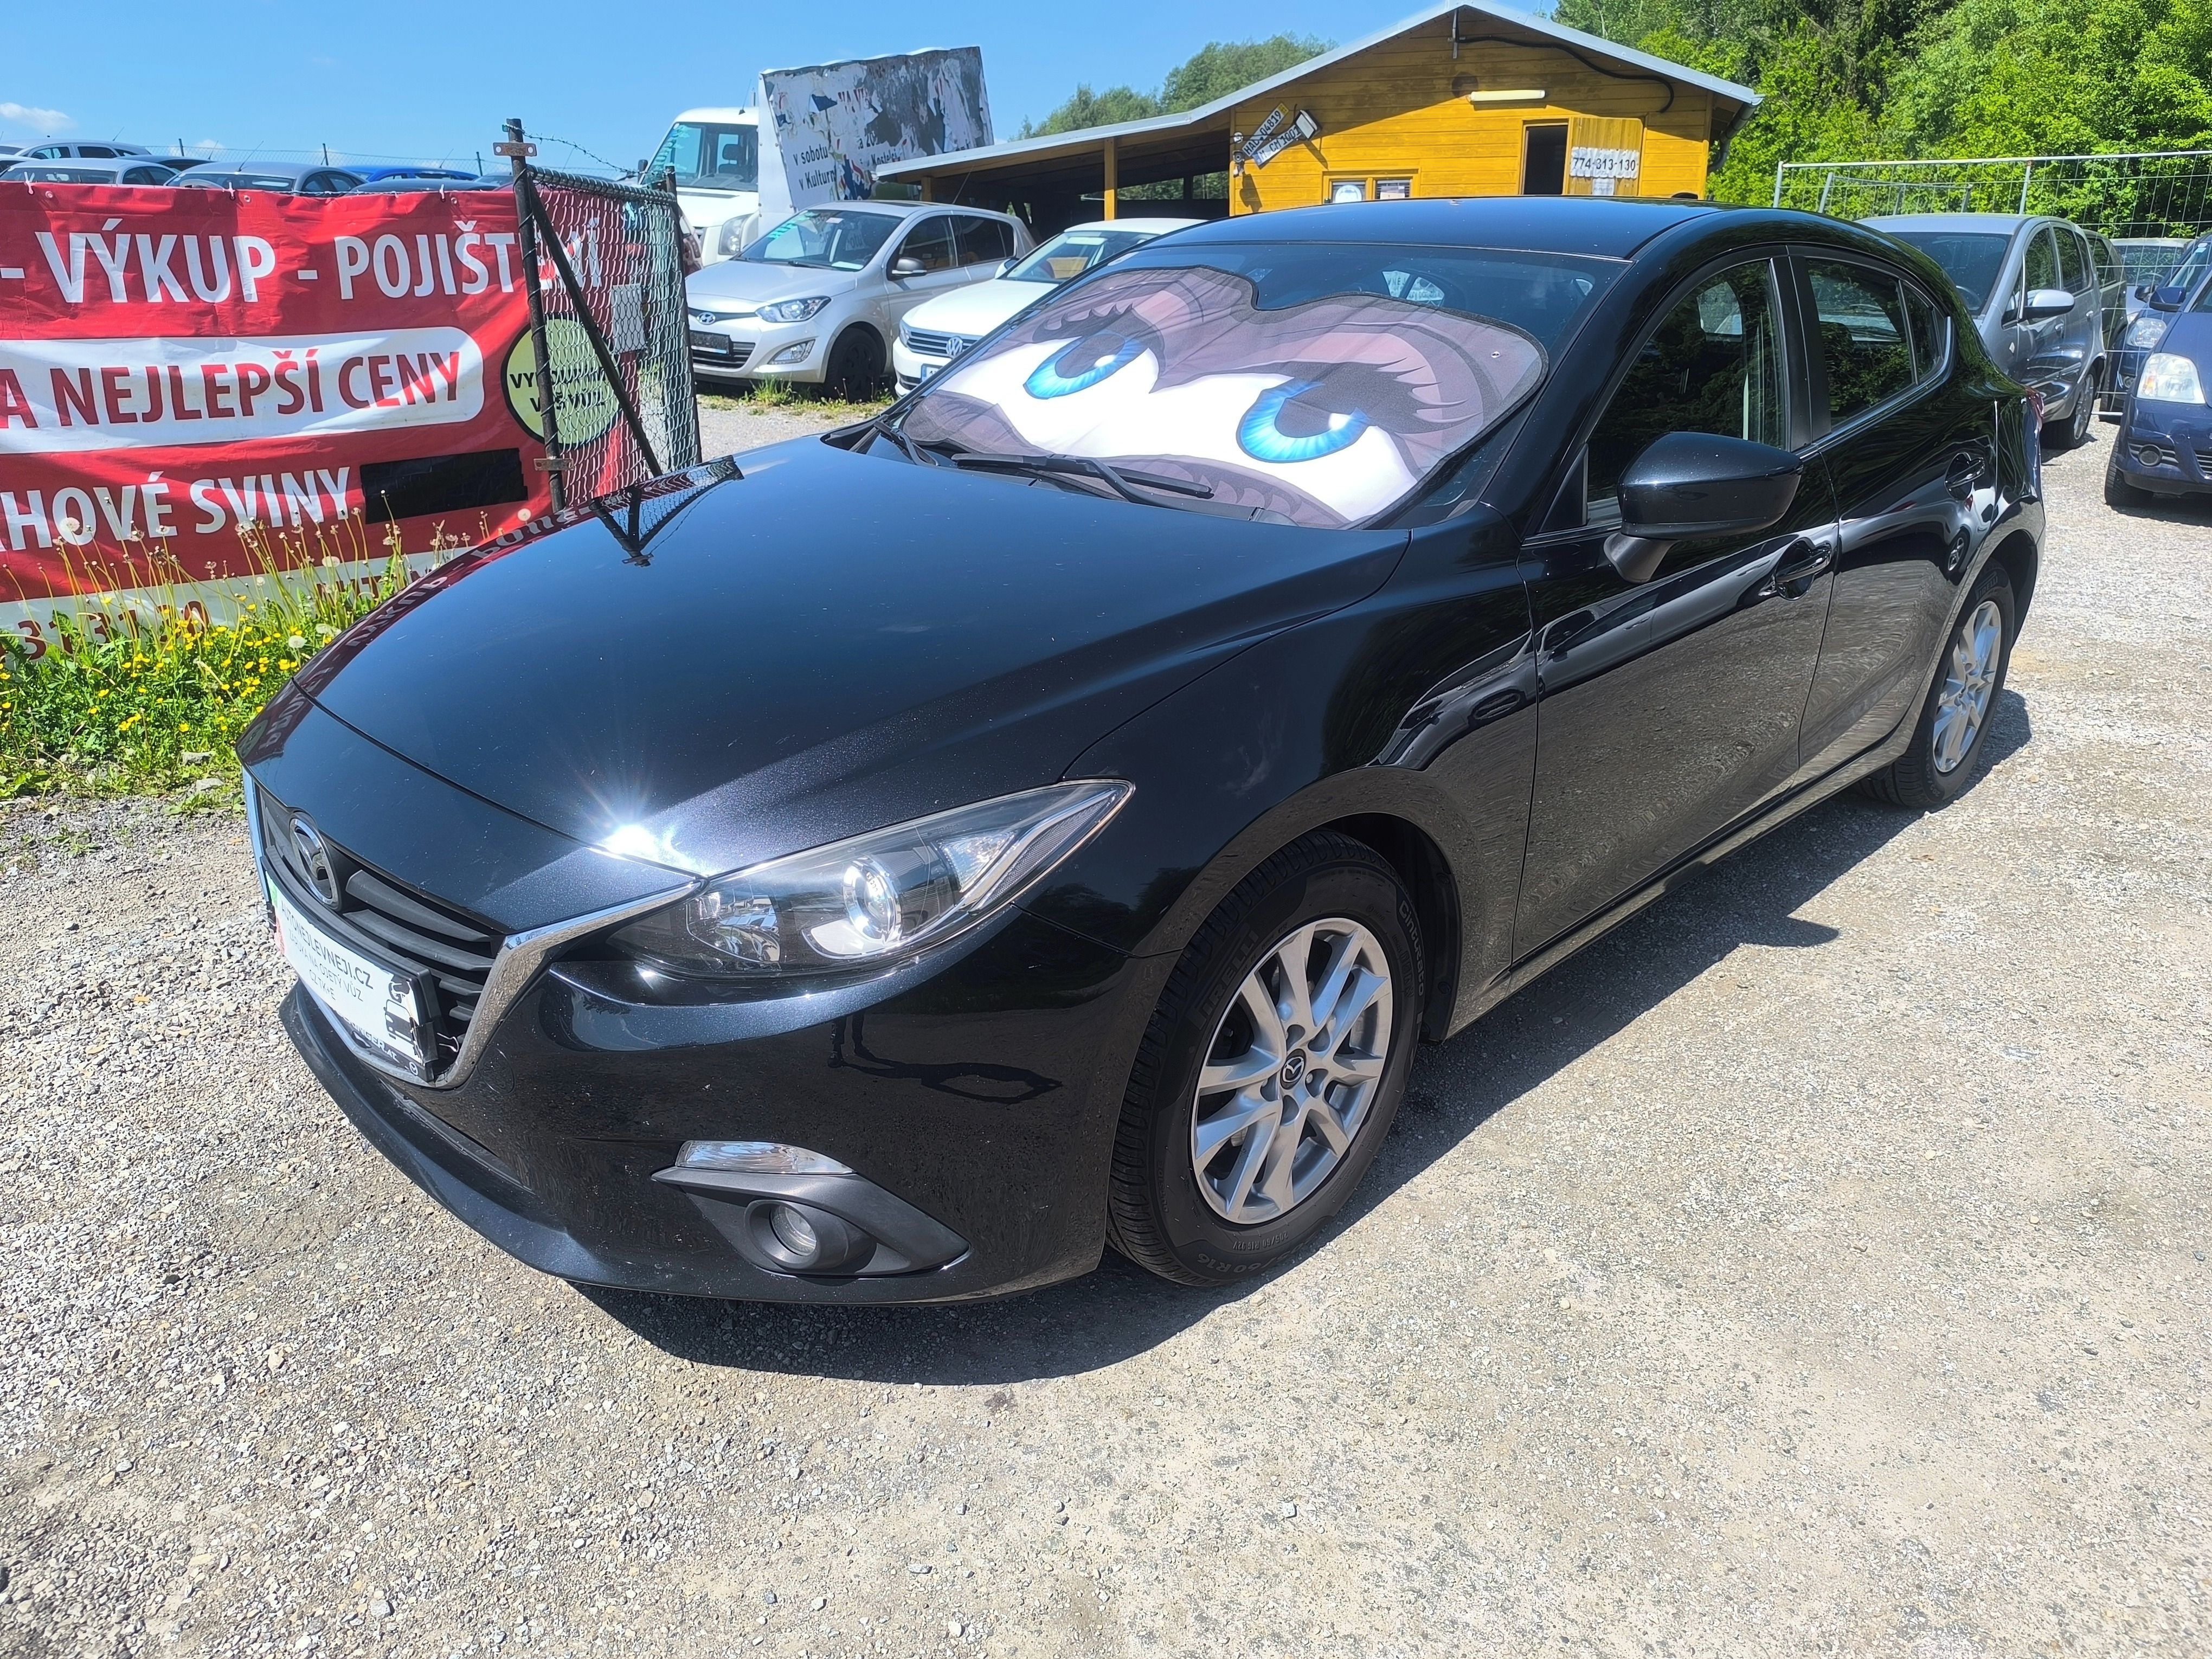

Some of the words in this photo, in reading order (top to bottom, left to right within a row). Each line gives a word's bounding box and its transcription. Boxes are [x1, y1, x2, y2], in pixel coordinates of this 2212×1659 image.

[1259, 110, 1282, 136] 04819
[801, 144, 828, 164] sobotu
[1269, 141, 1282, 152] CM
[1572, 157, 1636, 171] 774-313-130
[35, 218, 276, 304] VÝKUP
[50, 349, 324, 427] NEJLEPŠÍ
[338, 351, 460, 409] CENY
[0, 471, 177, 551] HOVÉ
[189, 466, 350, 534] SVINY
[1399, 899, 1424, 996] Cinturato
[343, 980, 364, 1002] VŮZ
